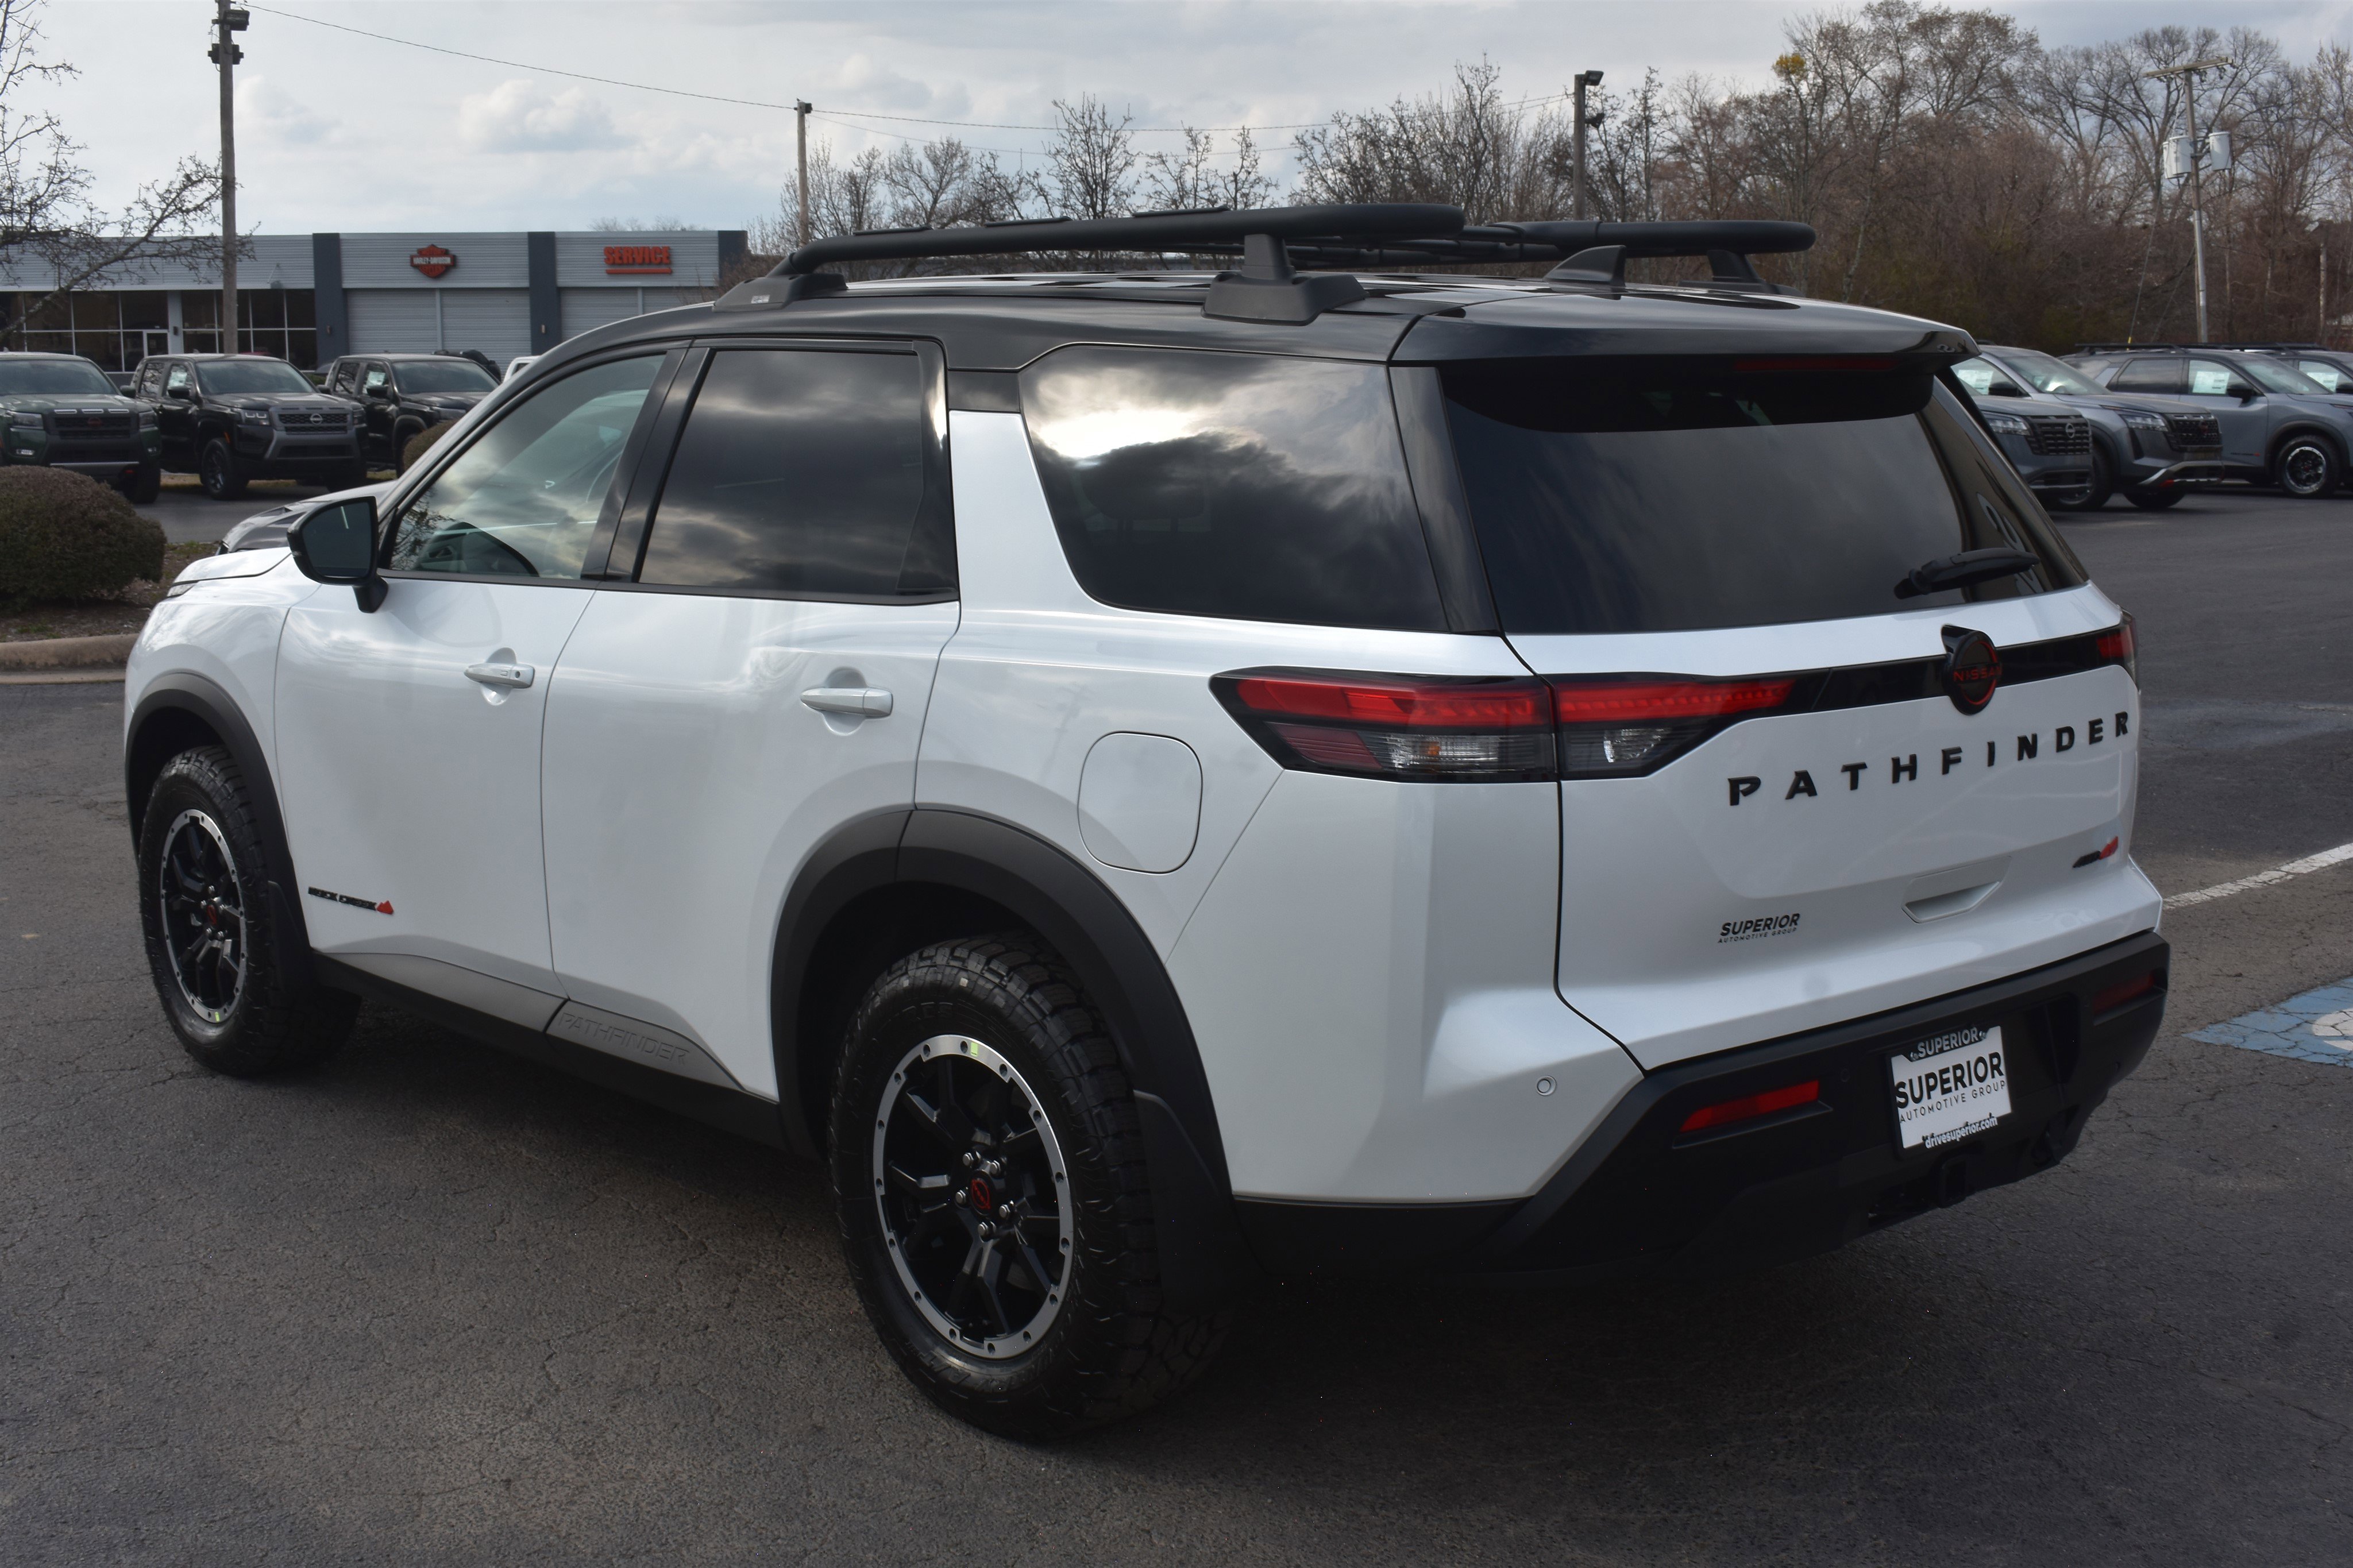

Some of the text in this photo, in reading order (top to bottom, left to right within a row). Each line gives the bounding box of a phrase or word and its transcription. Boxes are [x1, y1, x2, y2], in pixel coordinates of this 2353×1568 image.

[604, 246, 671, 265] SERVICE
[1953, 666, 2003, 681] NISSAN
[1727, 711, 2129, 806] PATHFINDER
[1718, 927, 1797, 944] AUTOMOTIVE GROUP
[1720, 913, 1800, 936] SUPERIOR
[558, 1012, 690, 1065] PATHFINDER
[1917, 1027, 1978, 1058] SUPERIOR
[1895, 1051, 2004, 1109] SUPERIOR
[1899, 1080, 2007, 1123] AUTOMOTIVE GROUP
[1925, 1116, 1999, 1149] drivesuperior.com
